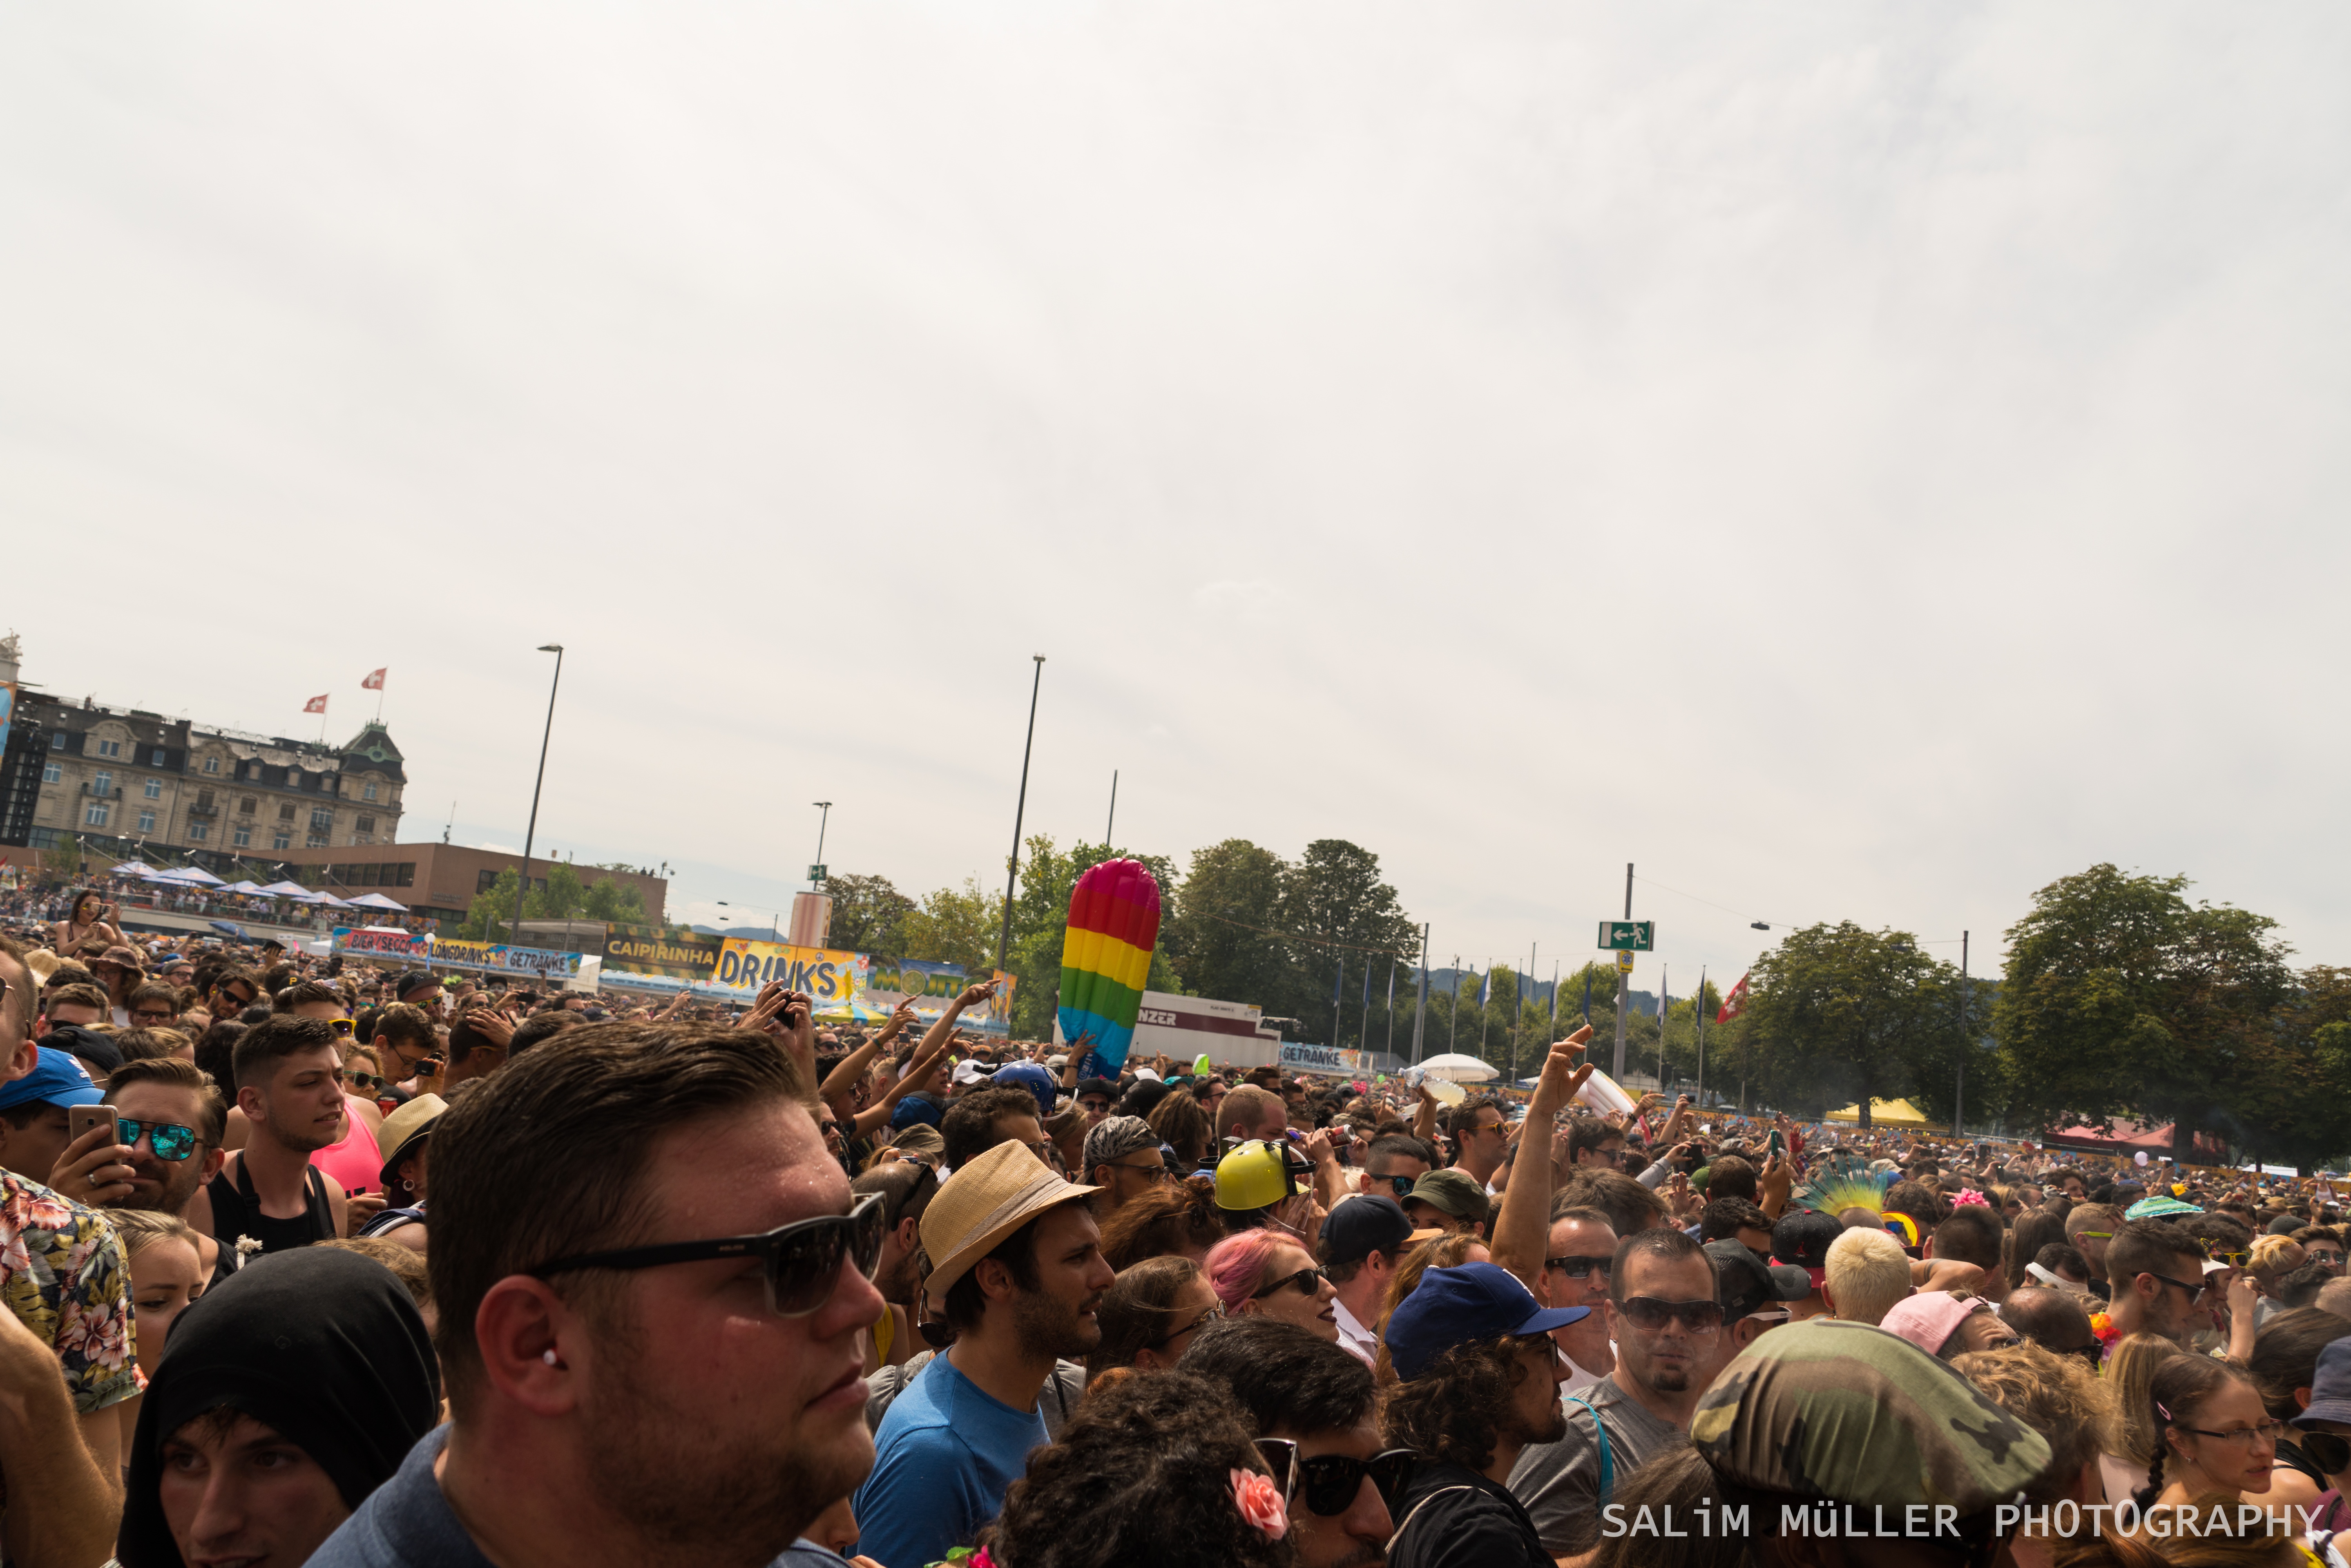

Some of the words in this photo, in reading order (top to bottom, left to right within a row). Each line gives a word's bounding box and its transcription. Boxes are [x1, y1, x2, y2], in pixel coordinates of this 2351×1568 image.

[431, 943, 491, 964] LONGDRINKS
[510, 951, 566, 972] GETRÄNKE
[608, 941, 714, 965] CAIPIRINHA
[290, 977, 297, 985] P
[719, 950, 837, 998] DRINKS
[1283, 1046, 1341, 1066] GETRÄNKE
